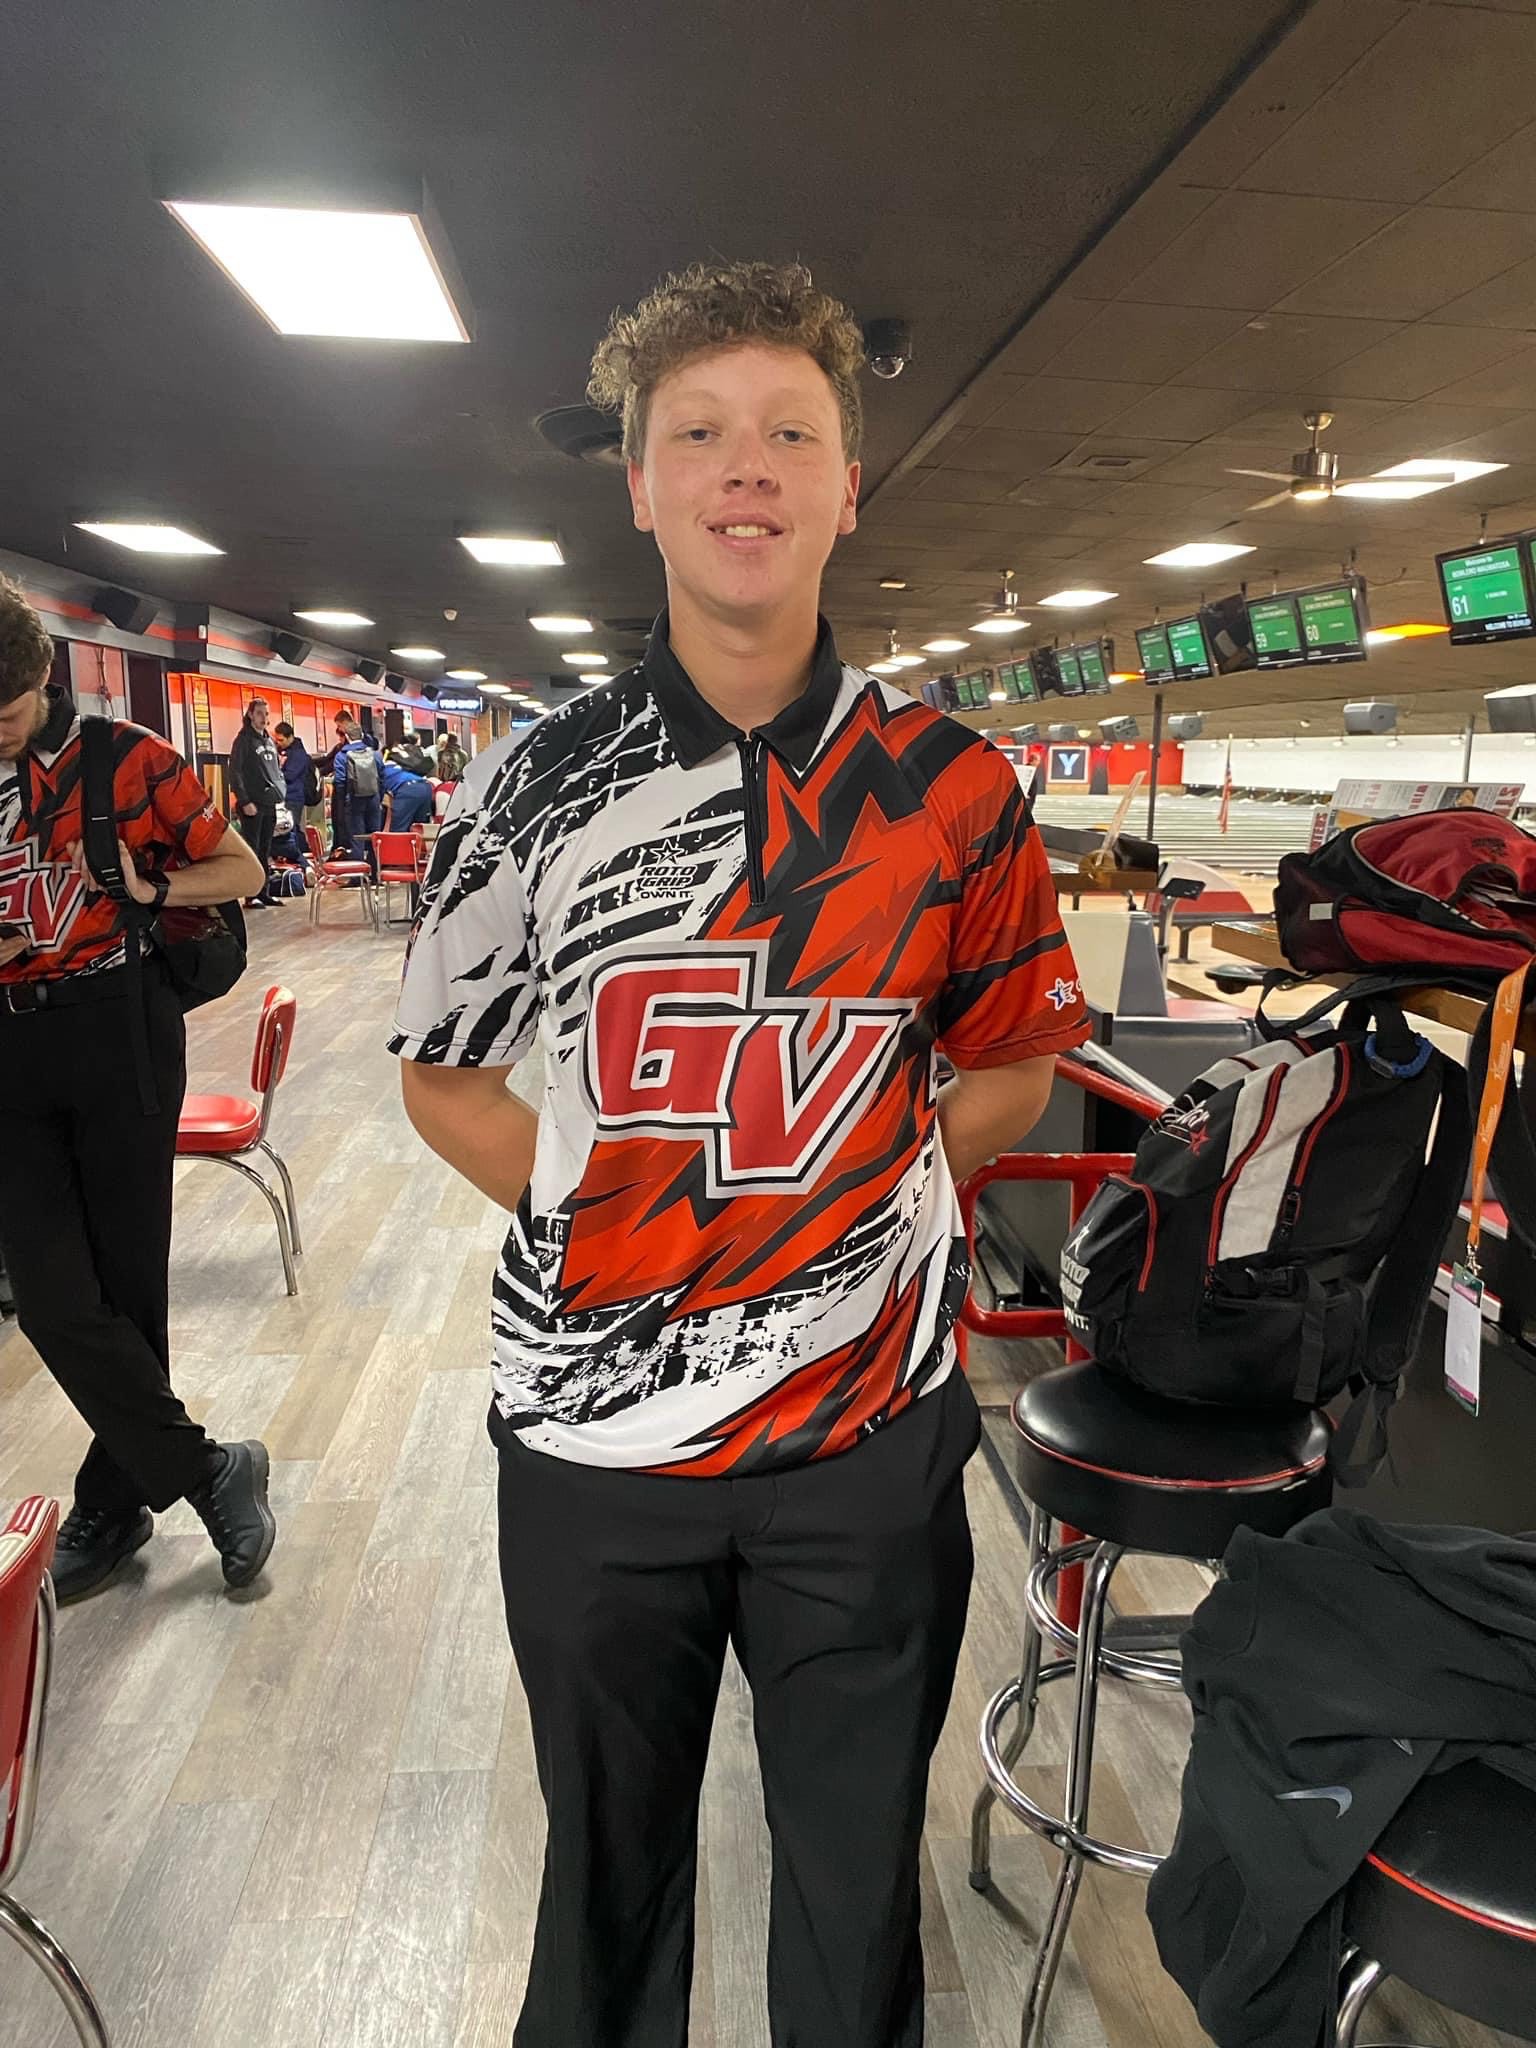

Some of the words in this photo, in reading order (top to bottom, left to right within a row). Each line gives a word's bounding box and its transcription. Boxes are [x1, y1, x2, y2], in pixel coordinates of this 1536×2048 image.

[1452, 594, 1469, 617] 61
[1058, 753, 1080, 776] Y
[640, 866, 697, 877] ROTO
[642, 877, 692, 887] GRIP
[679, 890, 694, 898] IT.
[586, 943, 918, 1196] GV
